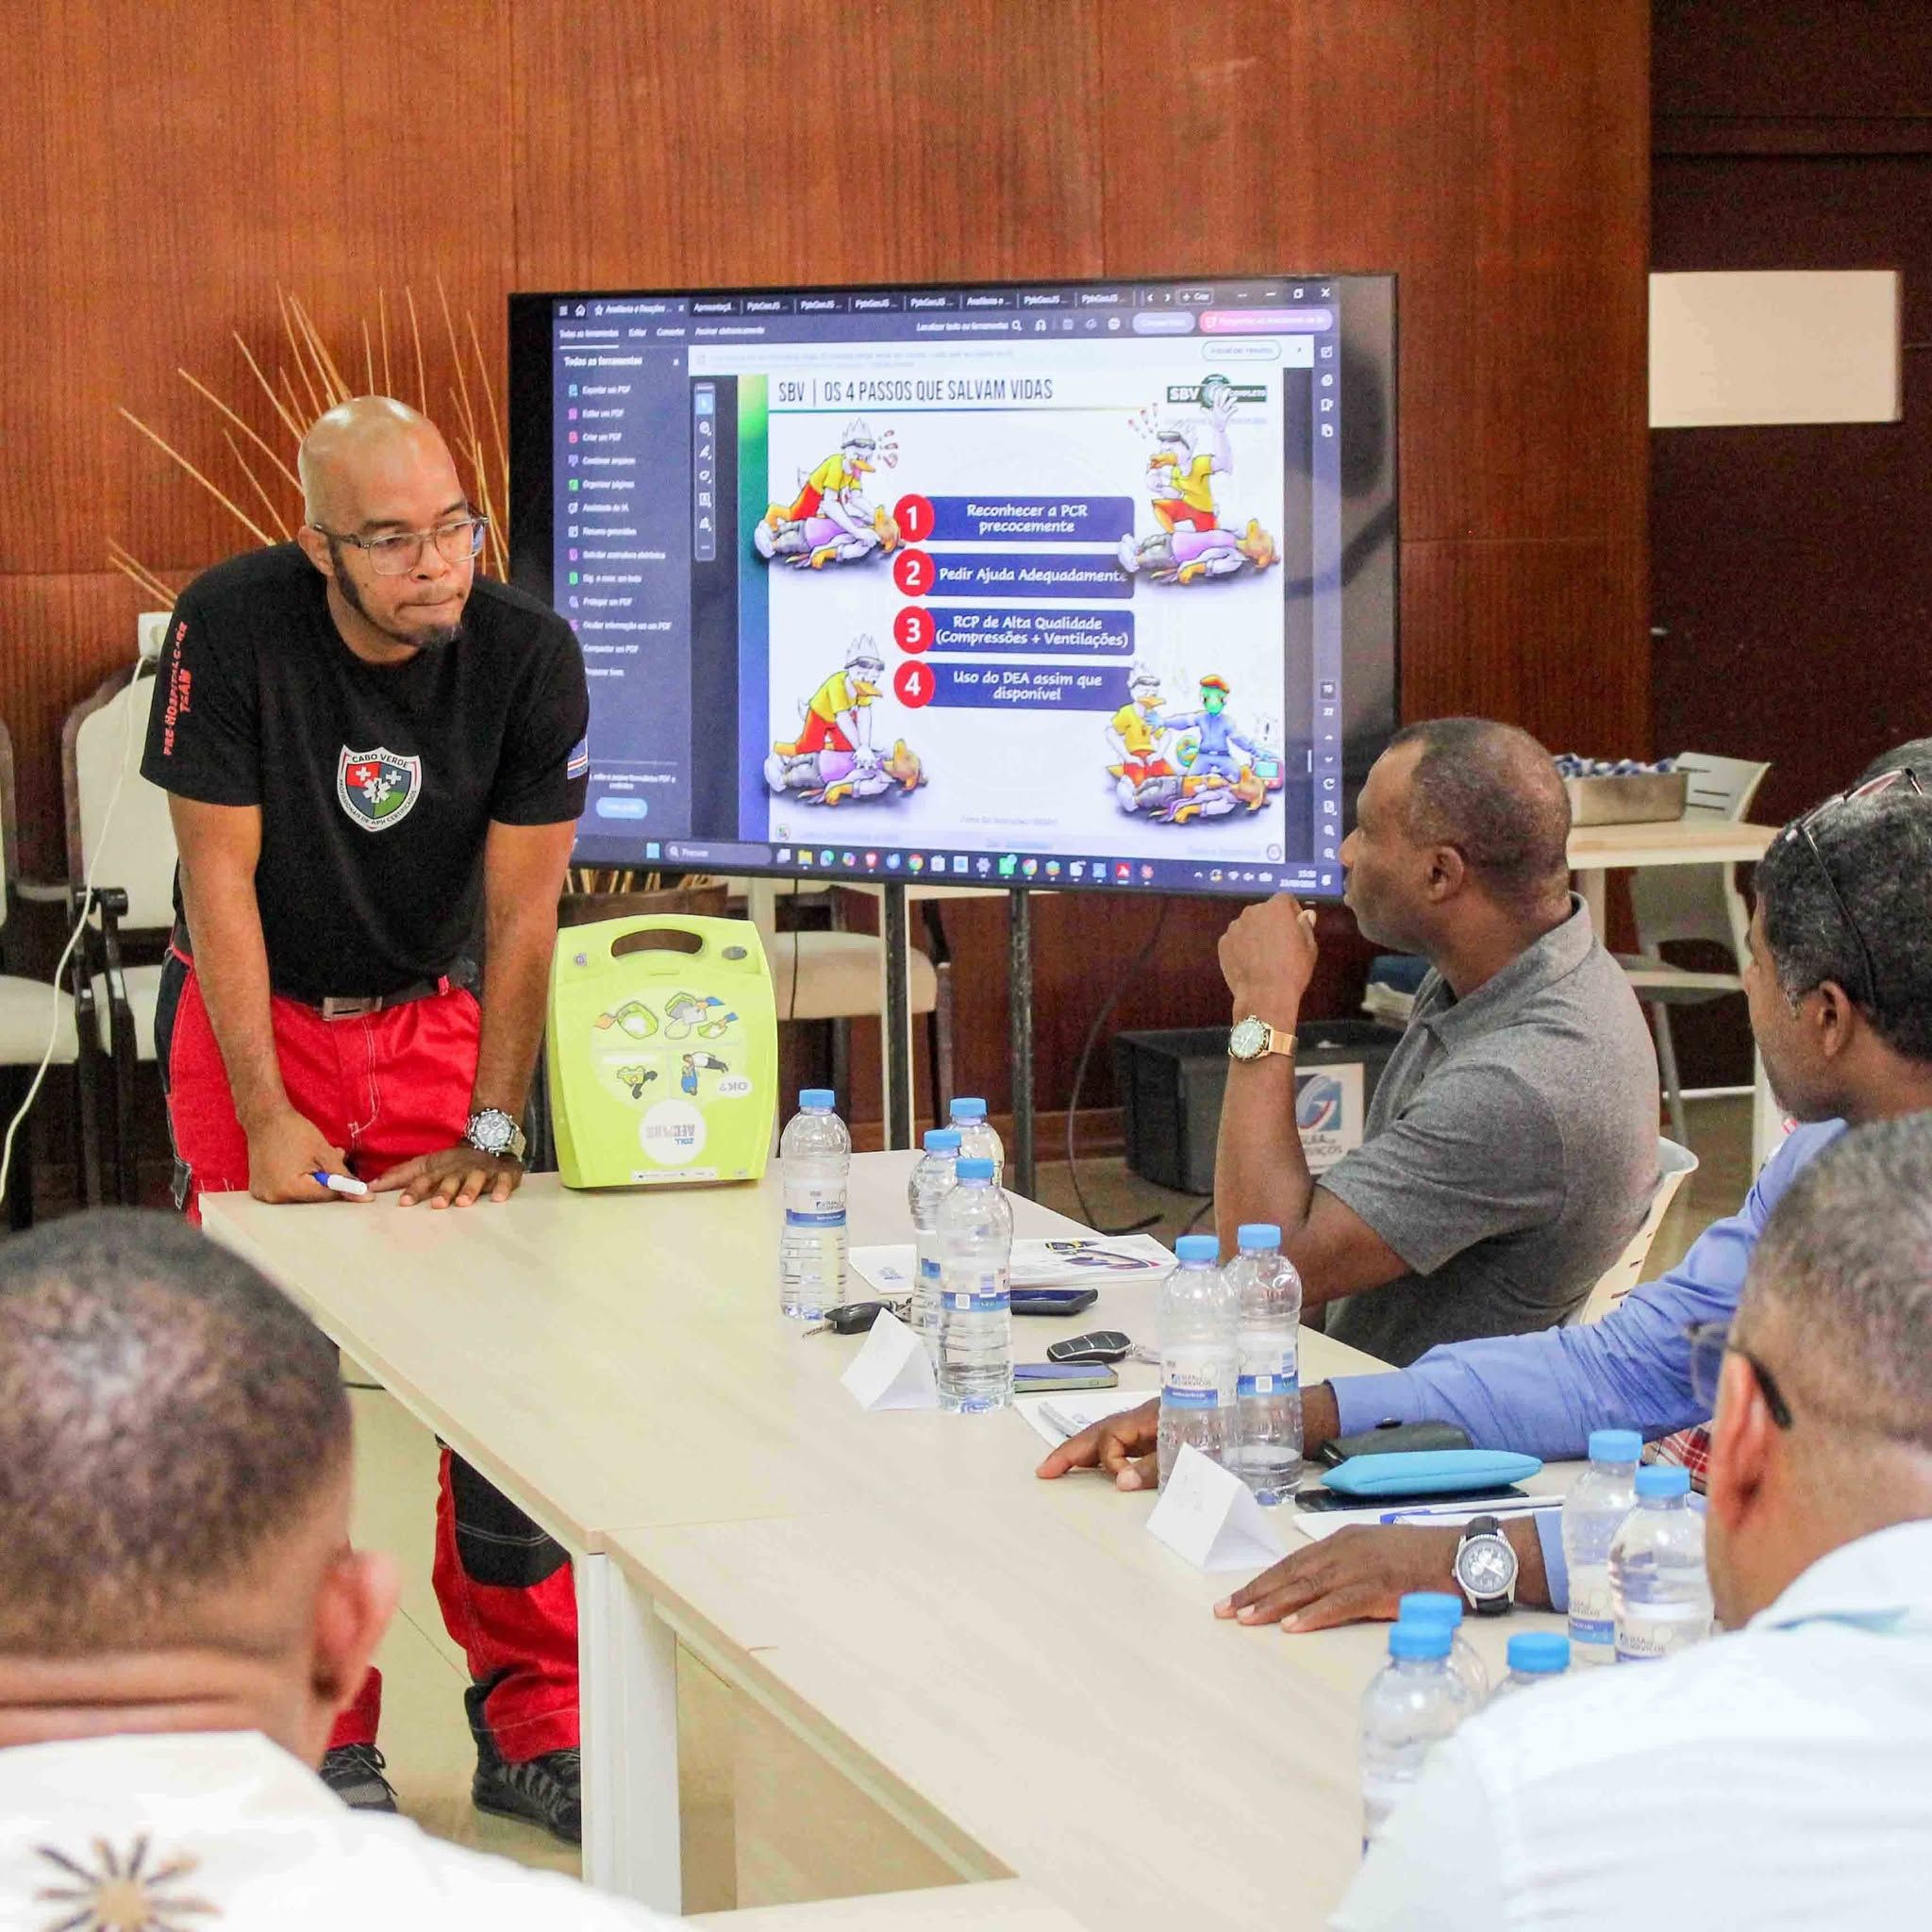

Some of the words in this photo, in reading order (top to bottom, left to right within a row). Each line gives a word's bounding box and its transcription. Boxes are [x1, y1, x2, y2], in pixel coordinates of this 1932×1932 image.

[779, 382, 805, 402] SBV
[824, 381, 841, 402] OS
[846, 381, 855, 402] 4
[859, 380, 912, 401] PASSOS
[917, 379, 943, 401] QUE
[948, 379, 1006, 400] SALVAM
[1011, 378, 1053, 400] VIDAS
[1170, 387, 1201, 401] SBV
[906, 505, 917, 530] 1
[966, 504, 1042, 517] Reconhecer
[1048, 508, 1057, 517] a
[1061, 504, 1088, 517] PCR
[978, 521, 1075, 535] precocemente
[906, 559, 921, 585] 2
[939, 568, 974, 581] Pedir
[976, 568, 1014, 584] Ajuda
[907, 618, 921, 642] 3
[954, 616, 980, 628] RCP
[983, 616, 999, 628] de
[1002, 616, 1031, 629] Alta
[1035, 617, 1102, 630] Qualidade
[936, 629, 1028, 646] (Compressões
[1044, 632, 1129, 649] Ventilações)
[905, 671, 922, 696] 4
[954, 671, 978, 683] Uso
[982, 671, 999, 684] do
[1003, 672, 1030, 684] DEA
[1033, 672, 1074, 685] assim
[1077, 675, 1103, 689] que
[993, 687, 1062, 702] disponível
[352, 754, 377, 763] CABO
[380, 754, 408, 769] VERDE
